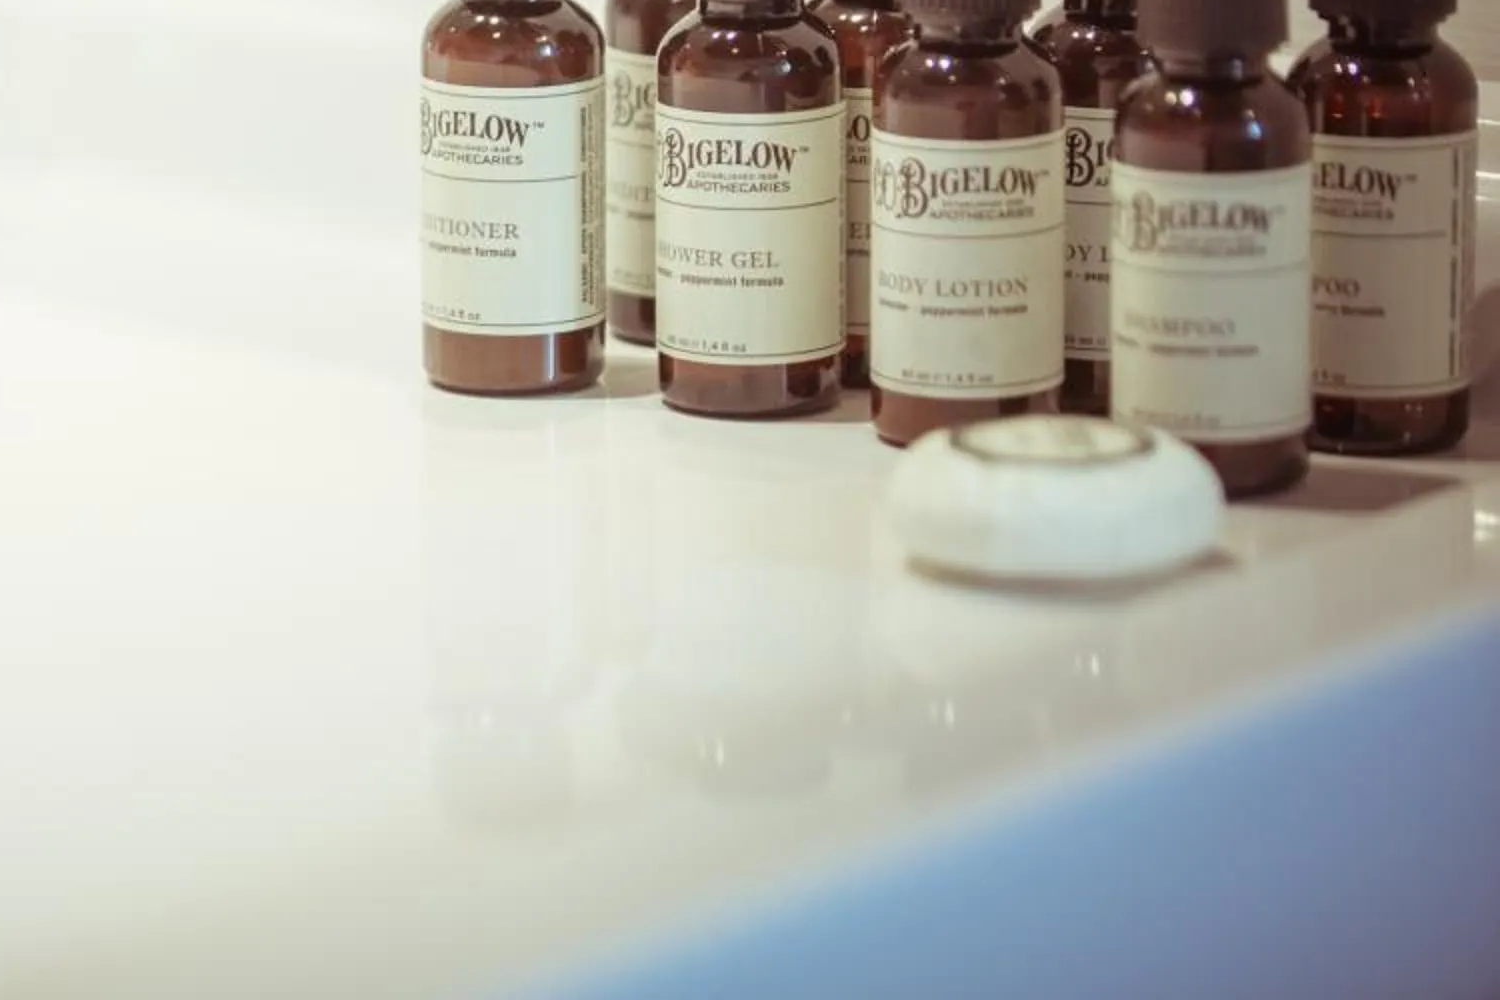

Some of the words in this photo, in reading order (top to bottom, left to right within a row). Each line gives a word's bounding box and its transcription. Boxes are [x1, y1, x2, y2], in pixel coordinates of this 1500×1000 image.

[663, 127, 798, 188] BIGELOW
[685, 180, 792, 194] APOTHECARIES
[1313, 161, 1402, 202] ELOW
[730, 248, 781, 269] GEL
[935, 276, 1030, 298] LOTION
